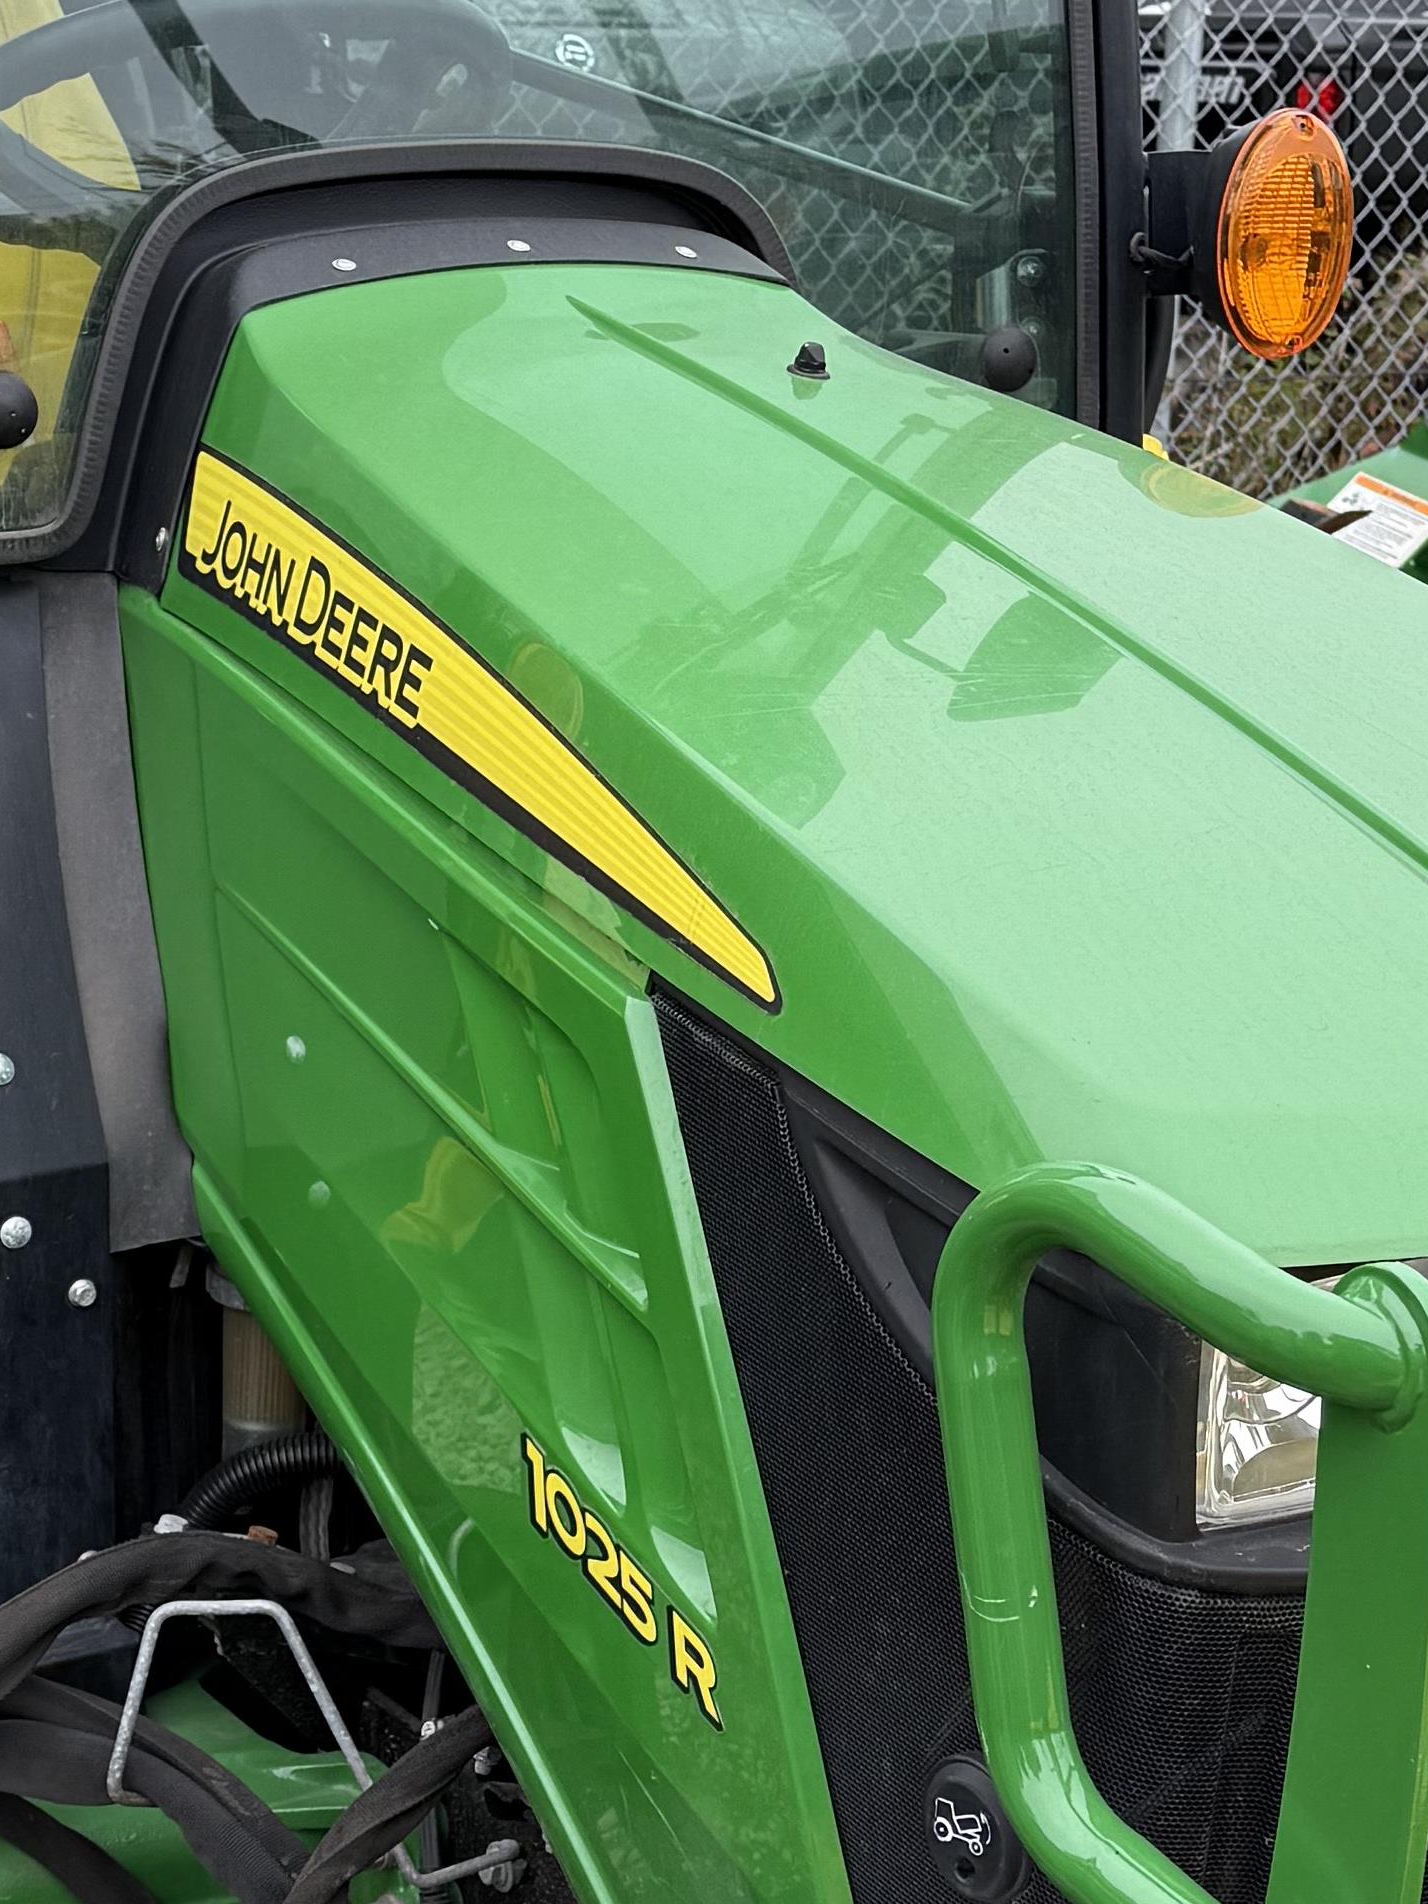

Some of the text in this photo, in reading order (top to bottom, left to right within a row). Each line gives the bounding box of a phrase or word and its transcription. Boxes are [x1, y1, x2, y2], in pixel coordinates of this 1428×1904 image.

[200, 499, 434, 720] JOHN DEERE
[523, 1434, 723, 1729] 1025 R
